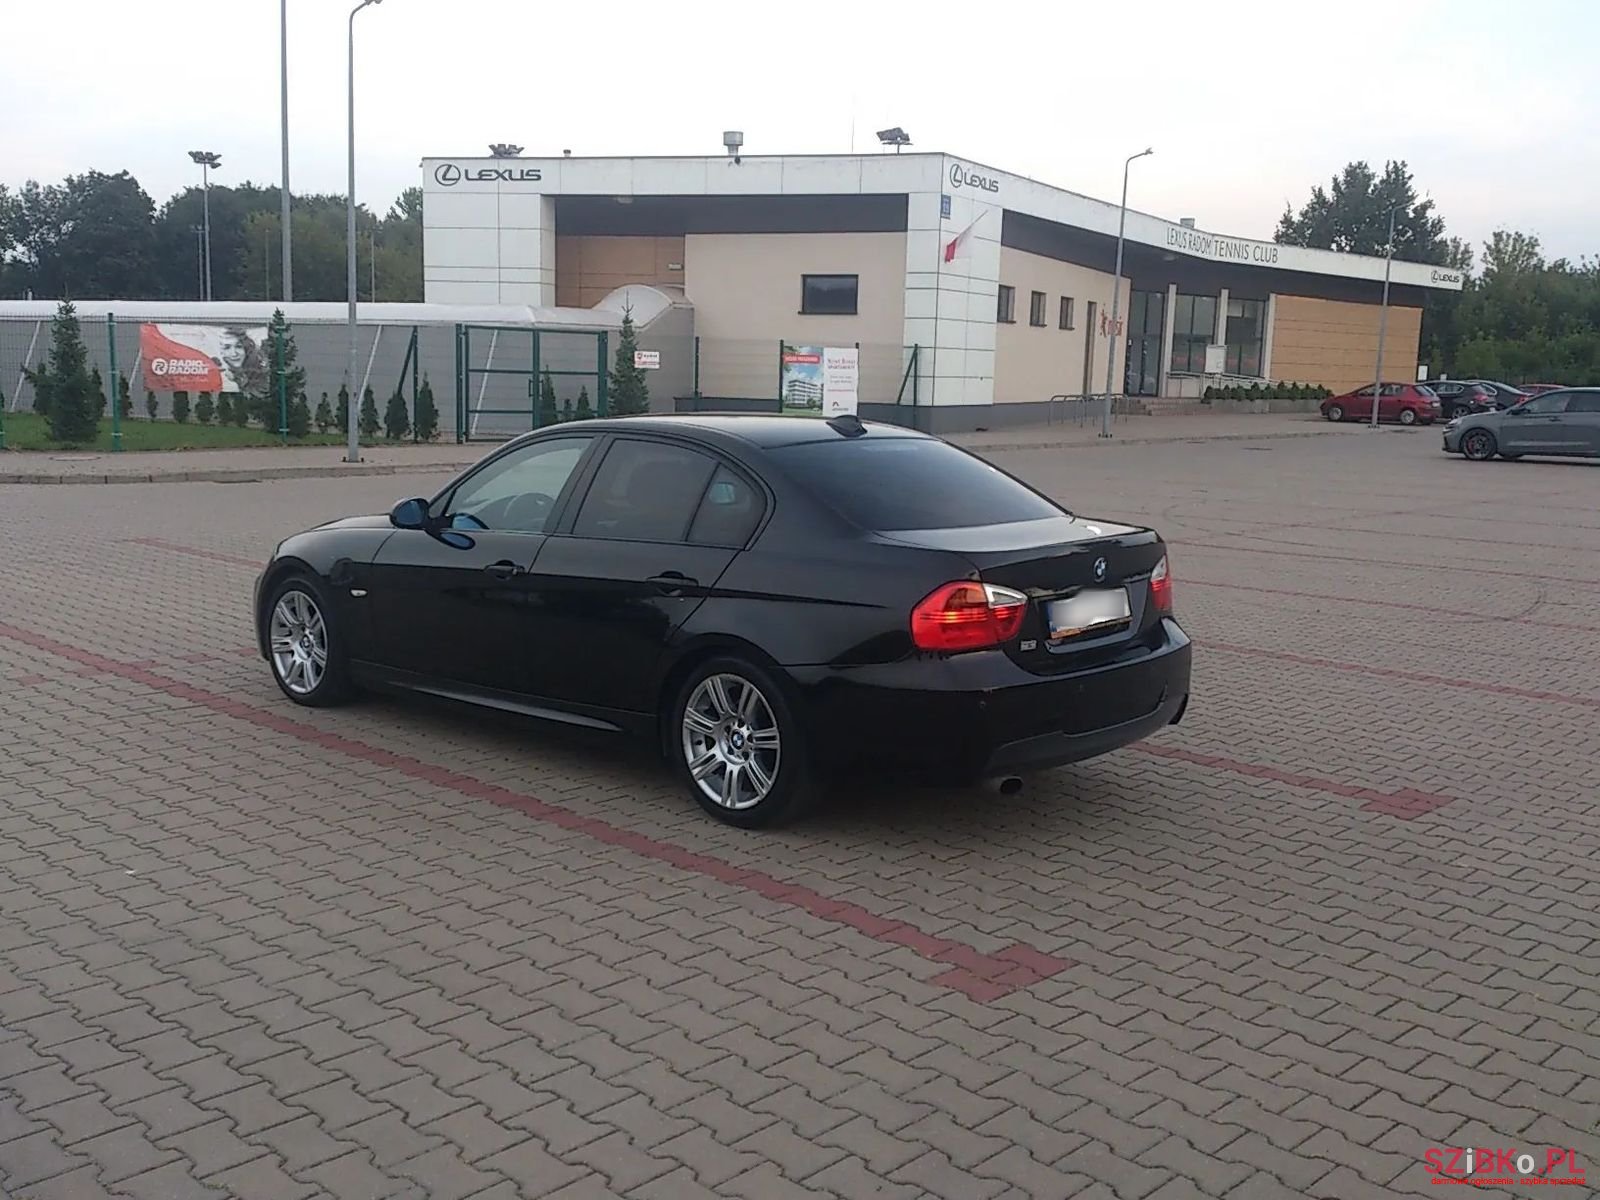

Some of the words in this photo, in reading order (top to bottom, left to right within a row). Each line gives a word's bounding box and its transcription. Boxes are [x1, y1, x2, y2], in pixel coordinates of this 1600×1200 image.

[464, 169, 541, 181] LEXUS
[964, 172, 998, 193] LEXUS
[1167, 227, 1187, 249] LEXUS
[1214, 239, 1249, 260] TENNIS
[1253, 245, 1278, 263] CLUB
[1439, 273, 1459, 283] LEXUS
[169, 359, 204, 367] RADIO
[168, 366, 209, 375] RADOM
